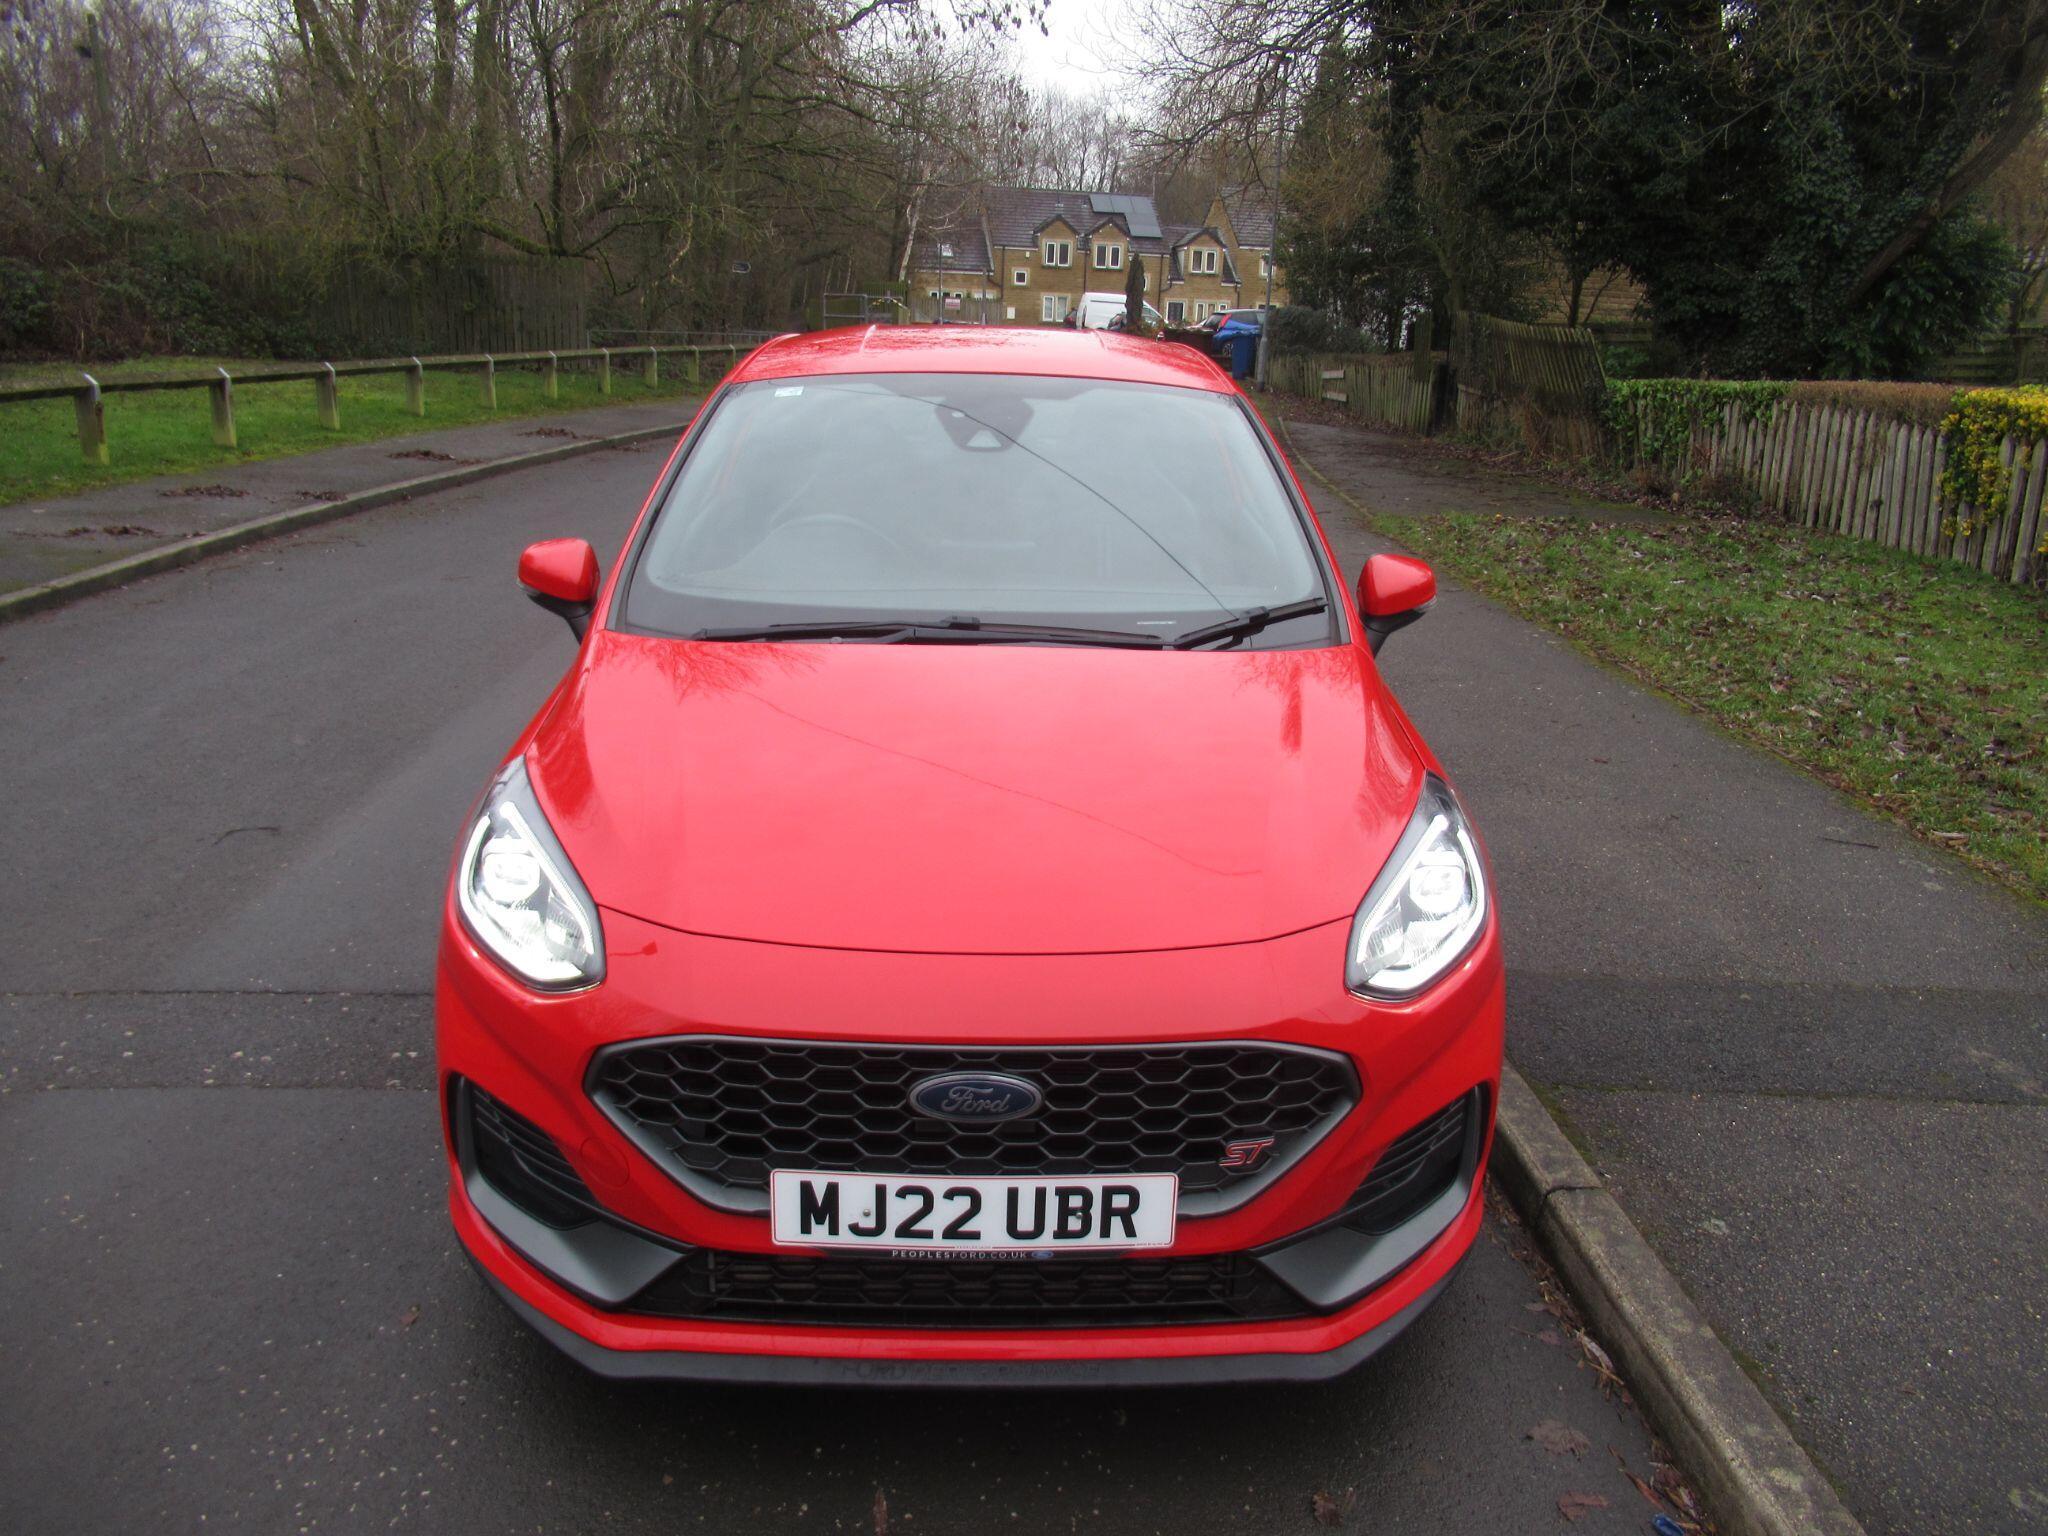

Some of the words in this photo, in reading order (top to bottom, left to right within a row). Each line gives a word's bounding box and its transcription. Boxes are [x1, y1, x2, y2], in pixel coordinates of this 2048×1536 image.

[941, 1085, 1011, 1112] Ford
[1219, 1136, 1275, 1166] ST
[799, 1180, 982, 1240] MJ22
[1005, 1184, 1141, 1240] UBR
[892, 1249, 1027, 1260] PEOPLESFORD.CO.UK
